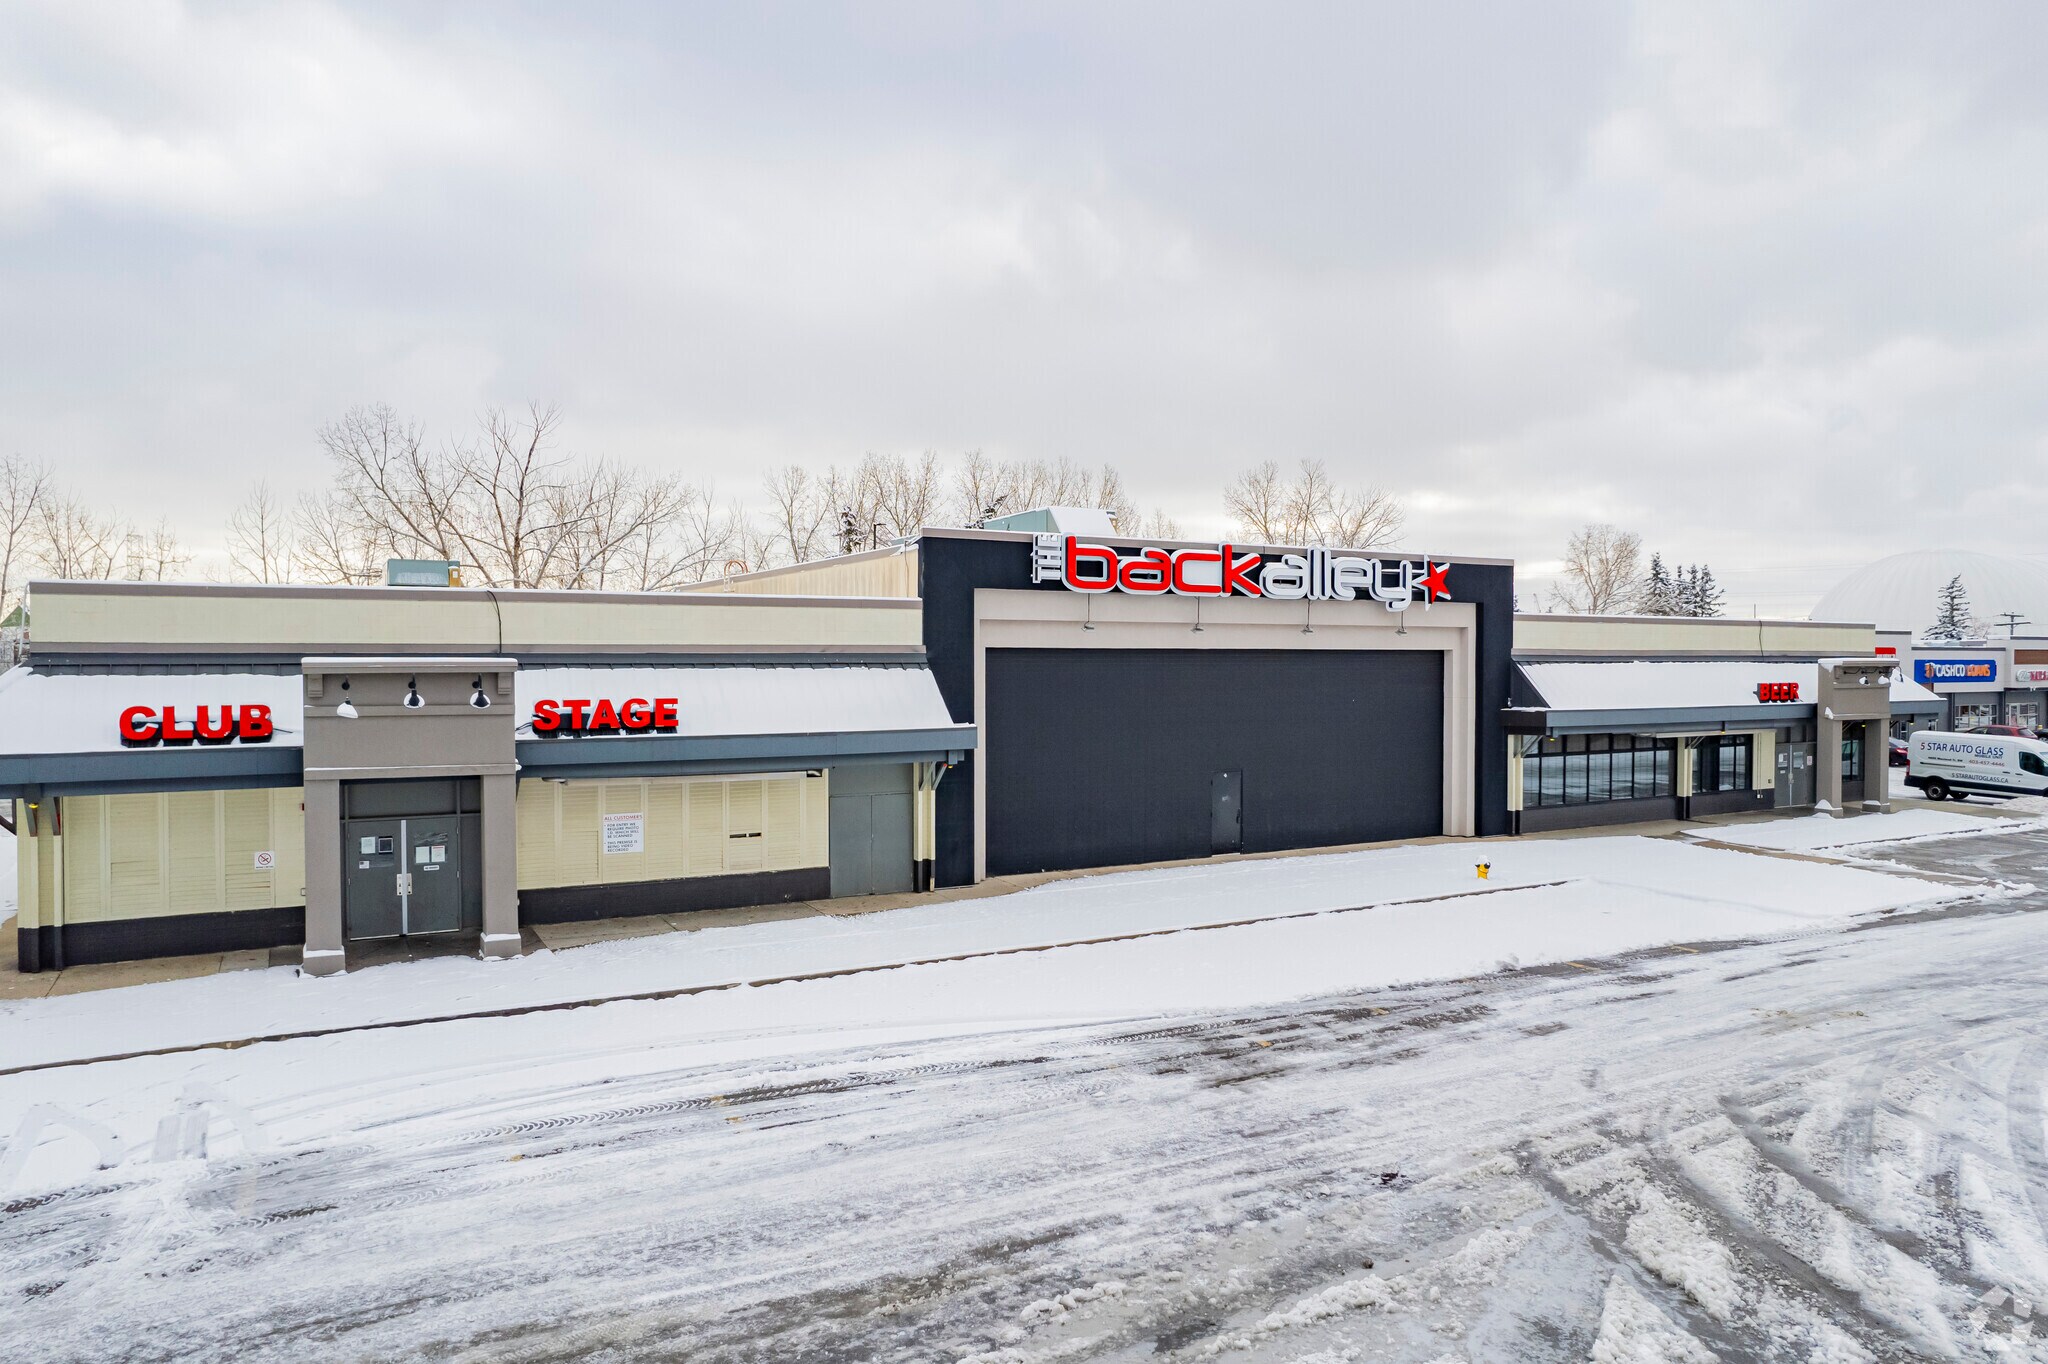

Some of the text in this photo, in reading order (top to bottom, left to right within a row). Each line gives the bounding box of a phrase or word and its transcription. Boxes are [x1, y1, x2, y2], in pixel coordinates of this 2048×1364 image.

[1032, 533, 1062, 584] THE
[1935, 664, 1991, 677] CASHCO LOANS
[1758, 682, 1800, 702] BEER
[119, 704, 273, 742] CLUB
[533, 698, 679, 732] STAGE
[1920, 742, 2004, 756] 5 STAR AUTO GLASS
